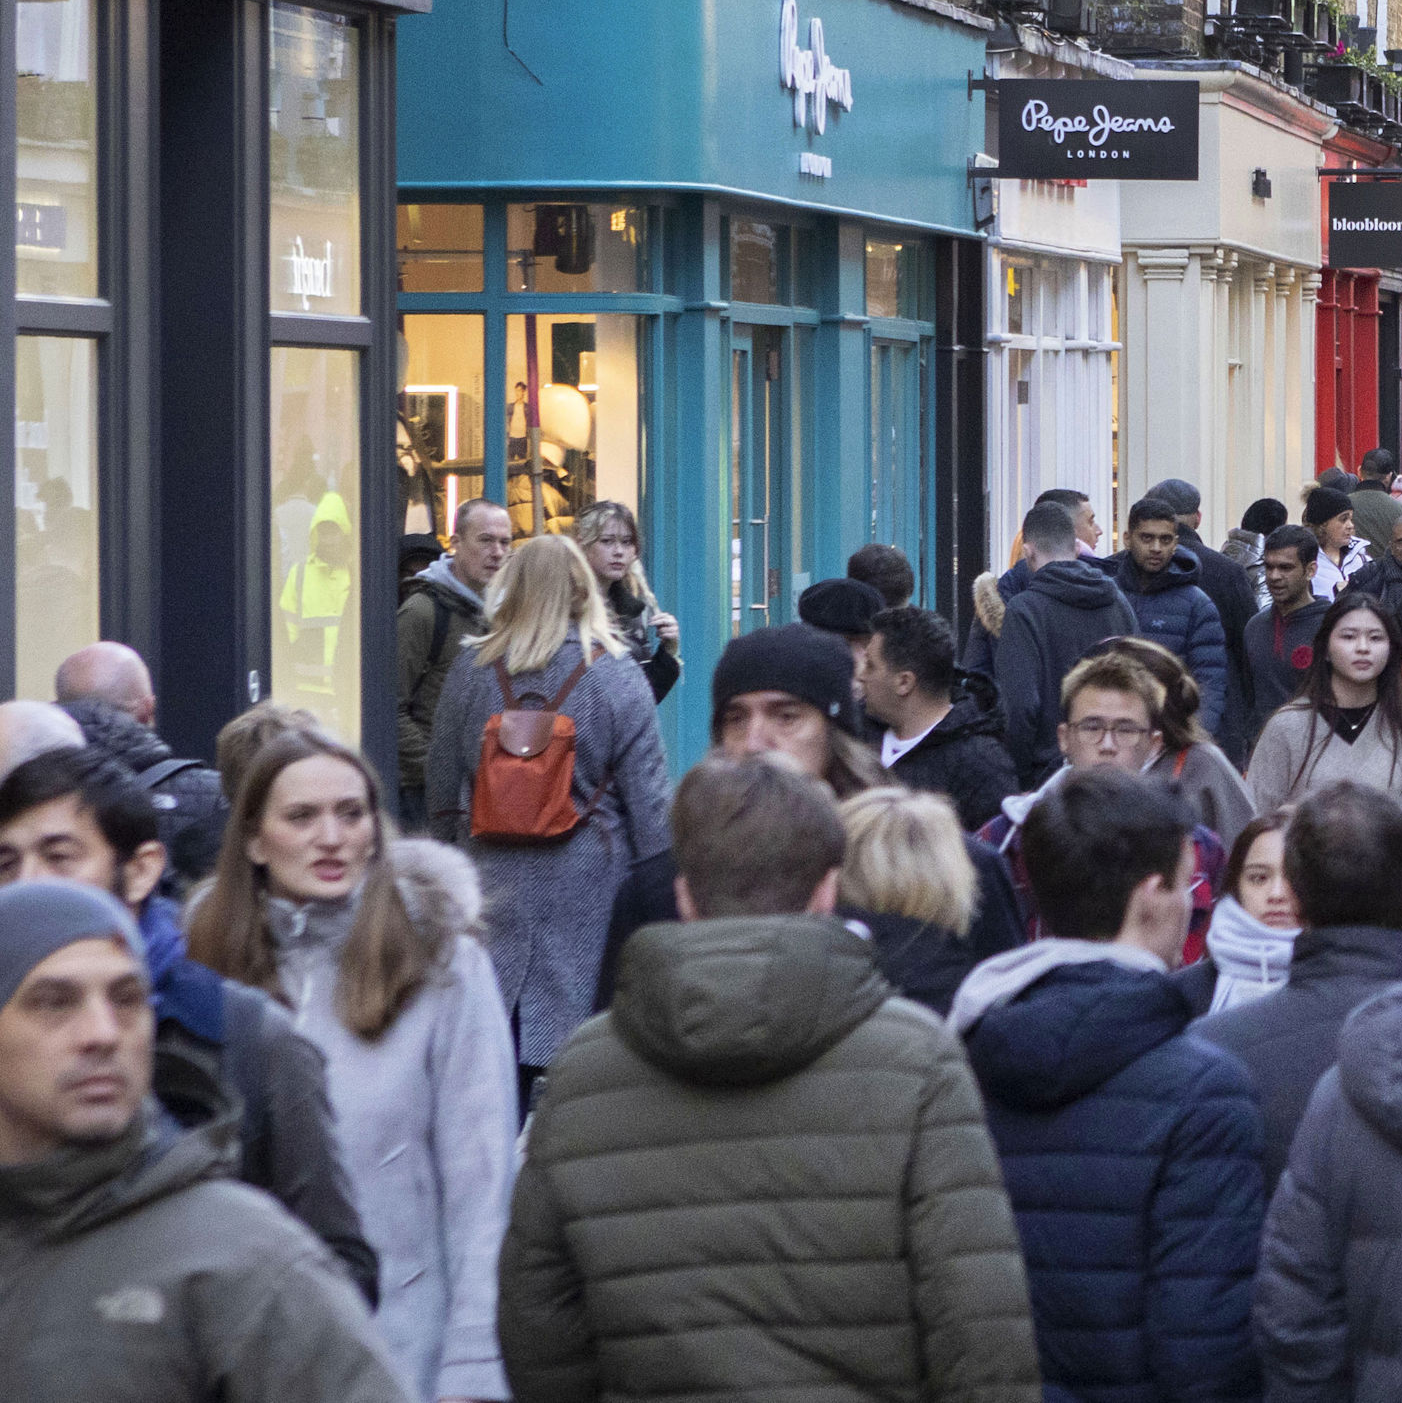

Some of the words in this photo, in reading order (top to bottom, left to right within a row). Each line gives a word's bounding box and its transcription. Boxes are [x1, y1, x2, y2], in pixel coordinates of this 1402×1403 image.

[1021, 99, 1090, 144] Pepe
[1088, 104, 1175, 147] Jeans
[1067, 149, 1131, 159] LONDON
